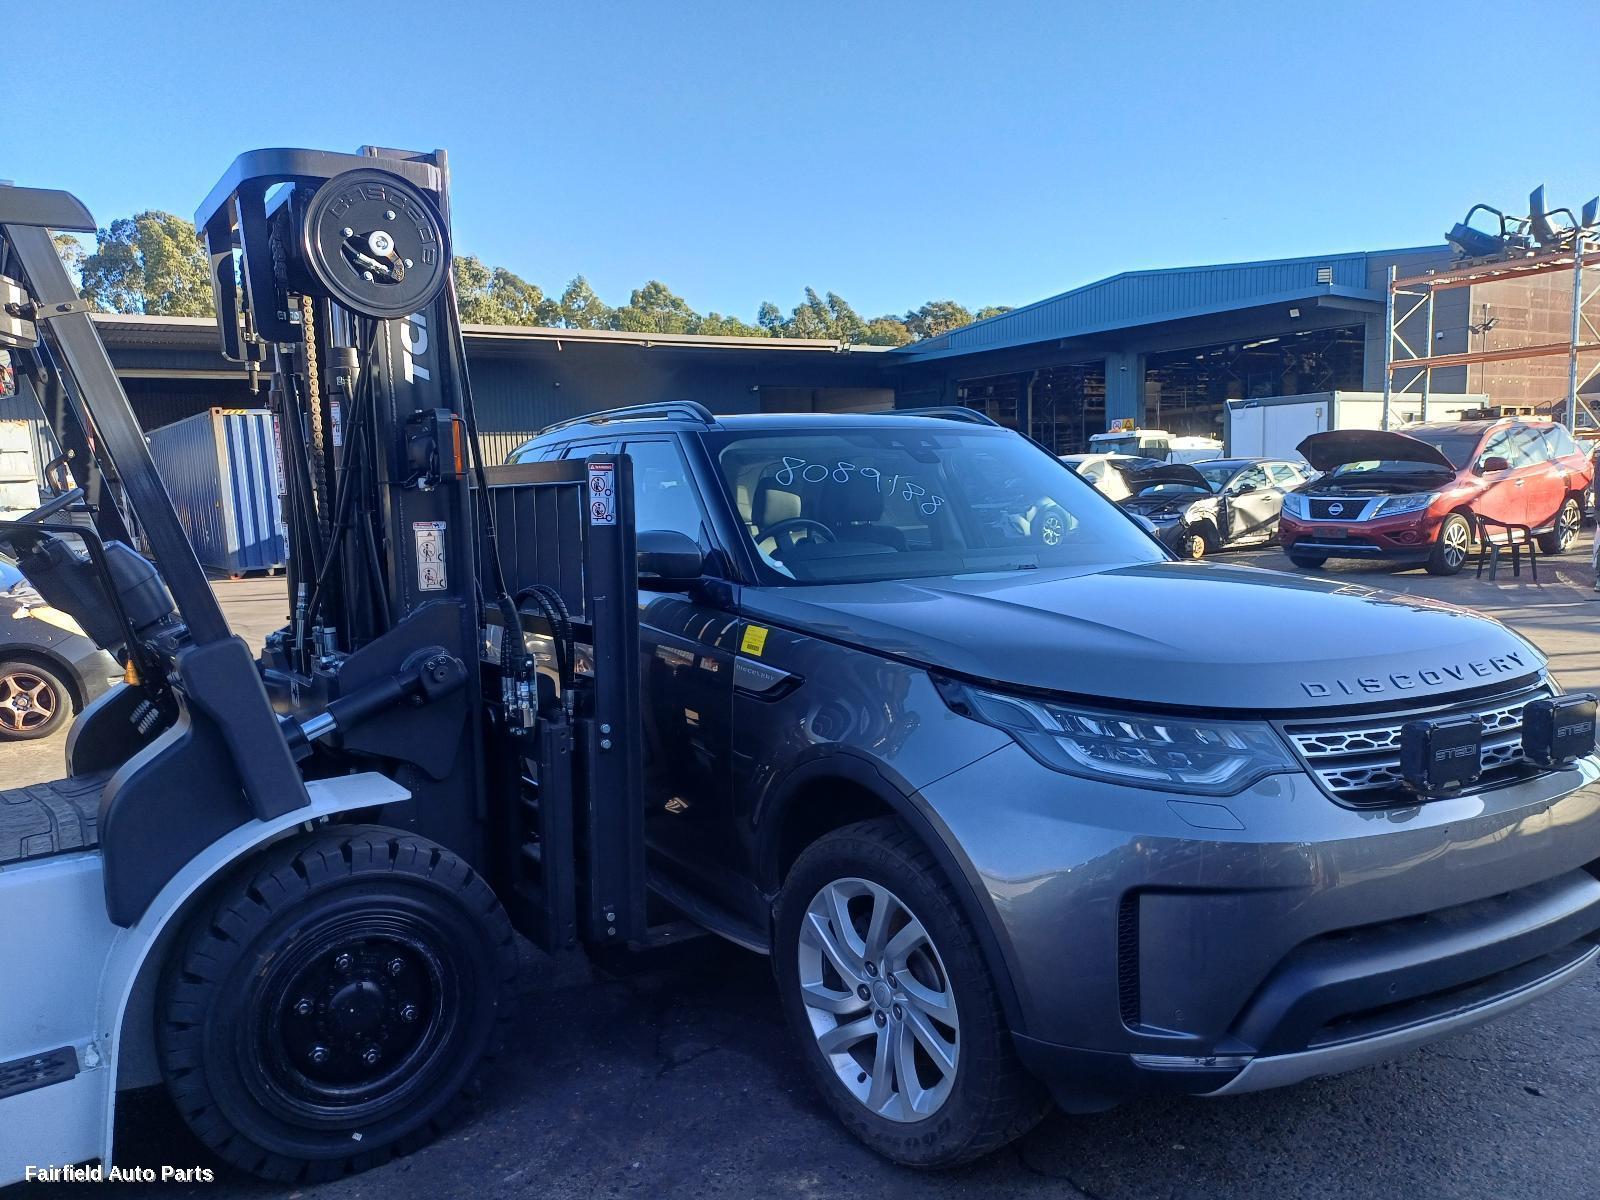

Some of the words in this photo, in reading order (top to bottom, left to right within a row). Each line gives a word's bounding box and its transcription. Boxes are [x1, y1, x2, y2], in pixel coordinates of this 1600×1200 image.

[401, 312, 429, 384] TC
[1300, 652, 1525, 698] DISCOVERY
[1556, 721, 1592, 738] STEDI
[1435, 743, 1477, 762] STEDI
